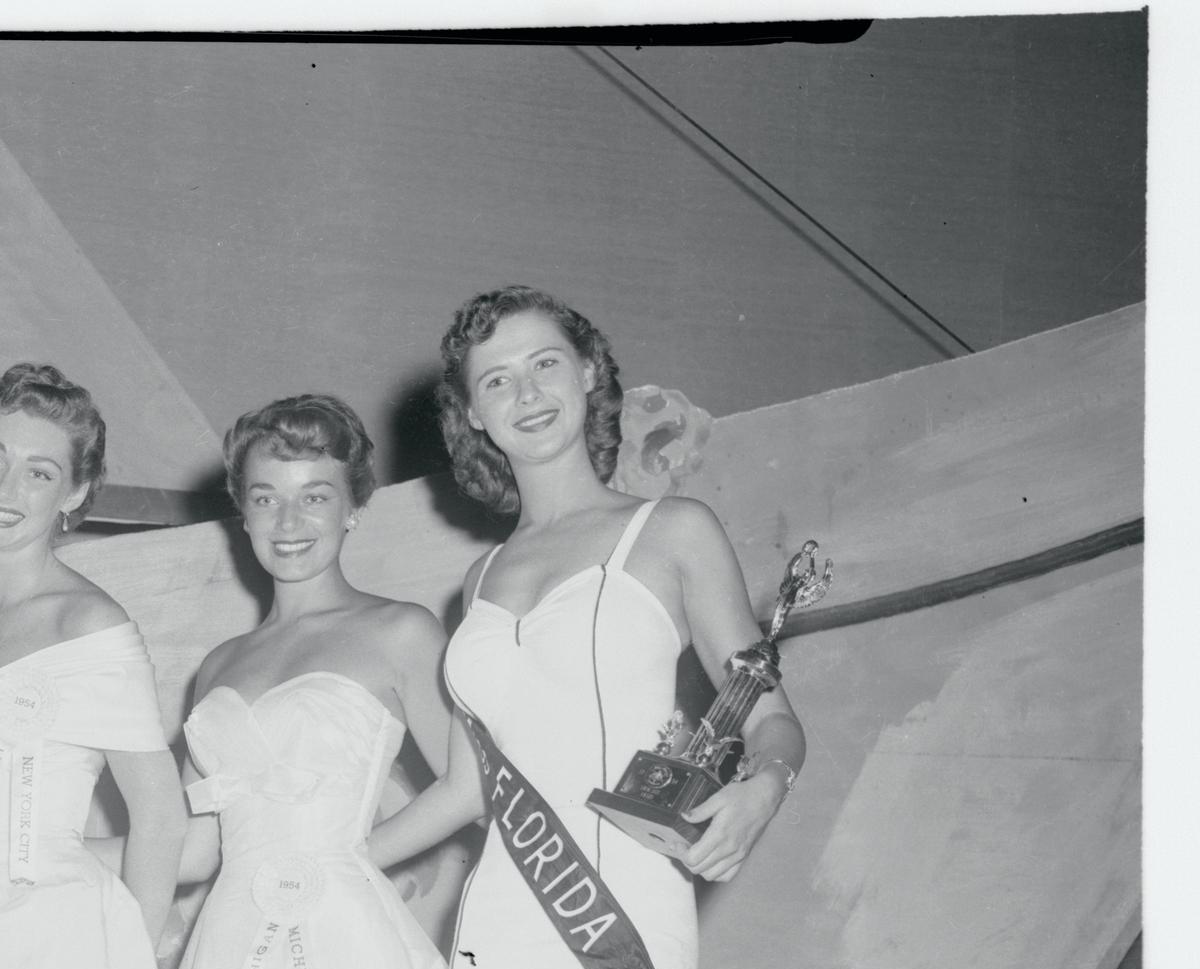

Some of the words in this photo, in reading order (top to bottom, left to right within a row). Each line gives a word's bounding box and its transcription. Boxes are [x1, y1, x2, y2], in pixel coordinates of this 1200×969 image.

[13, 695, 36, 710] 1954
[21, 756, 35, 787] NEW
[19, 790, 33, 829] YORK
[18, 832, 32, 864] CITY
[491, 765, 619, 954] FLORIDA
[278, 879, 301, 890] 1954
